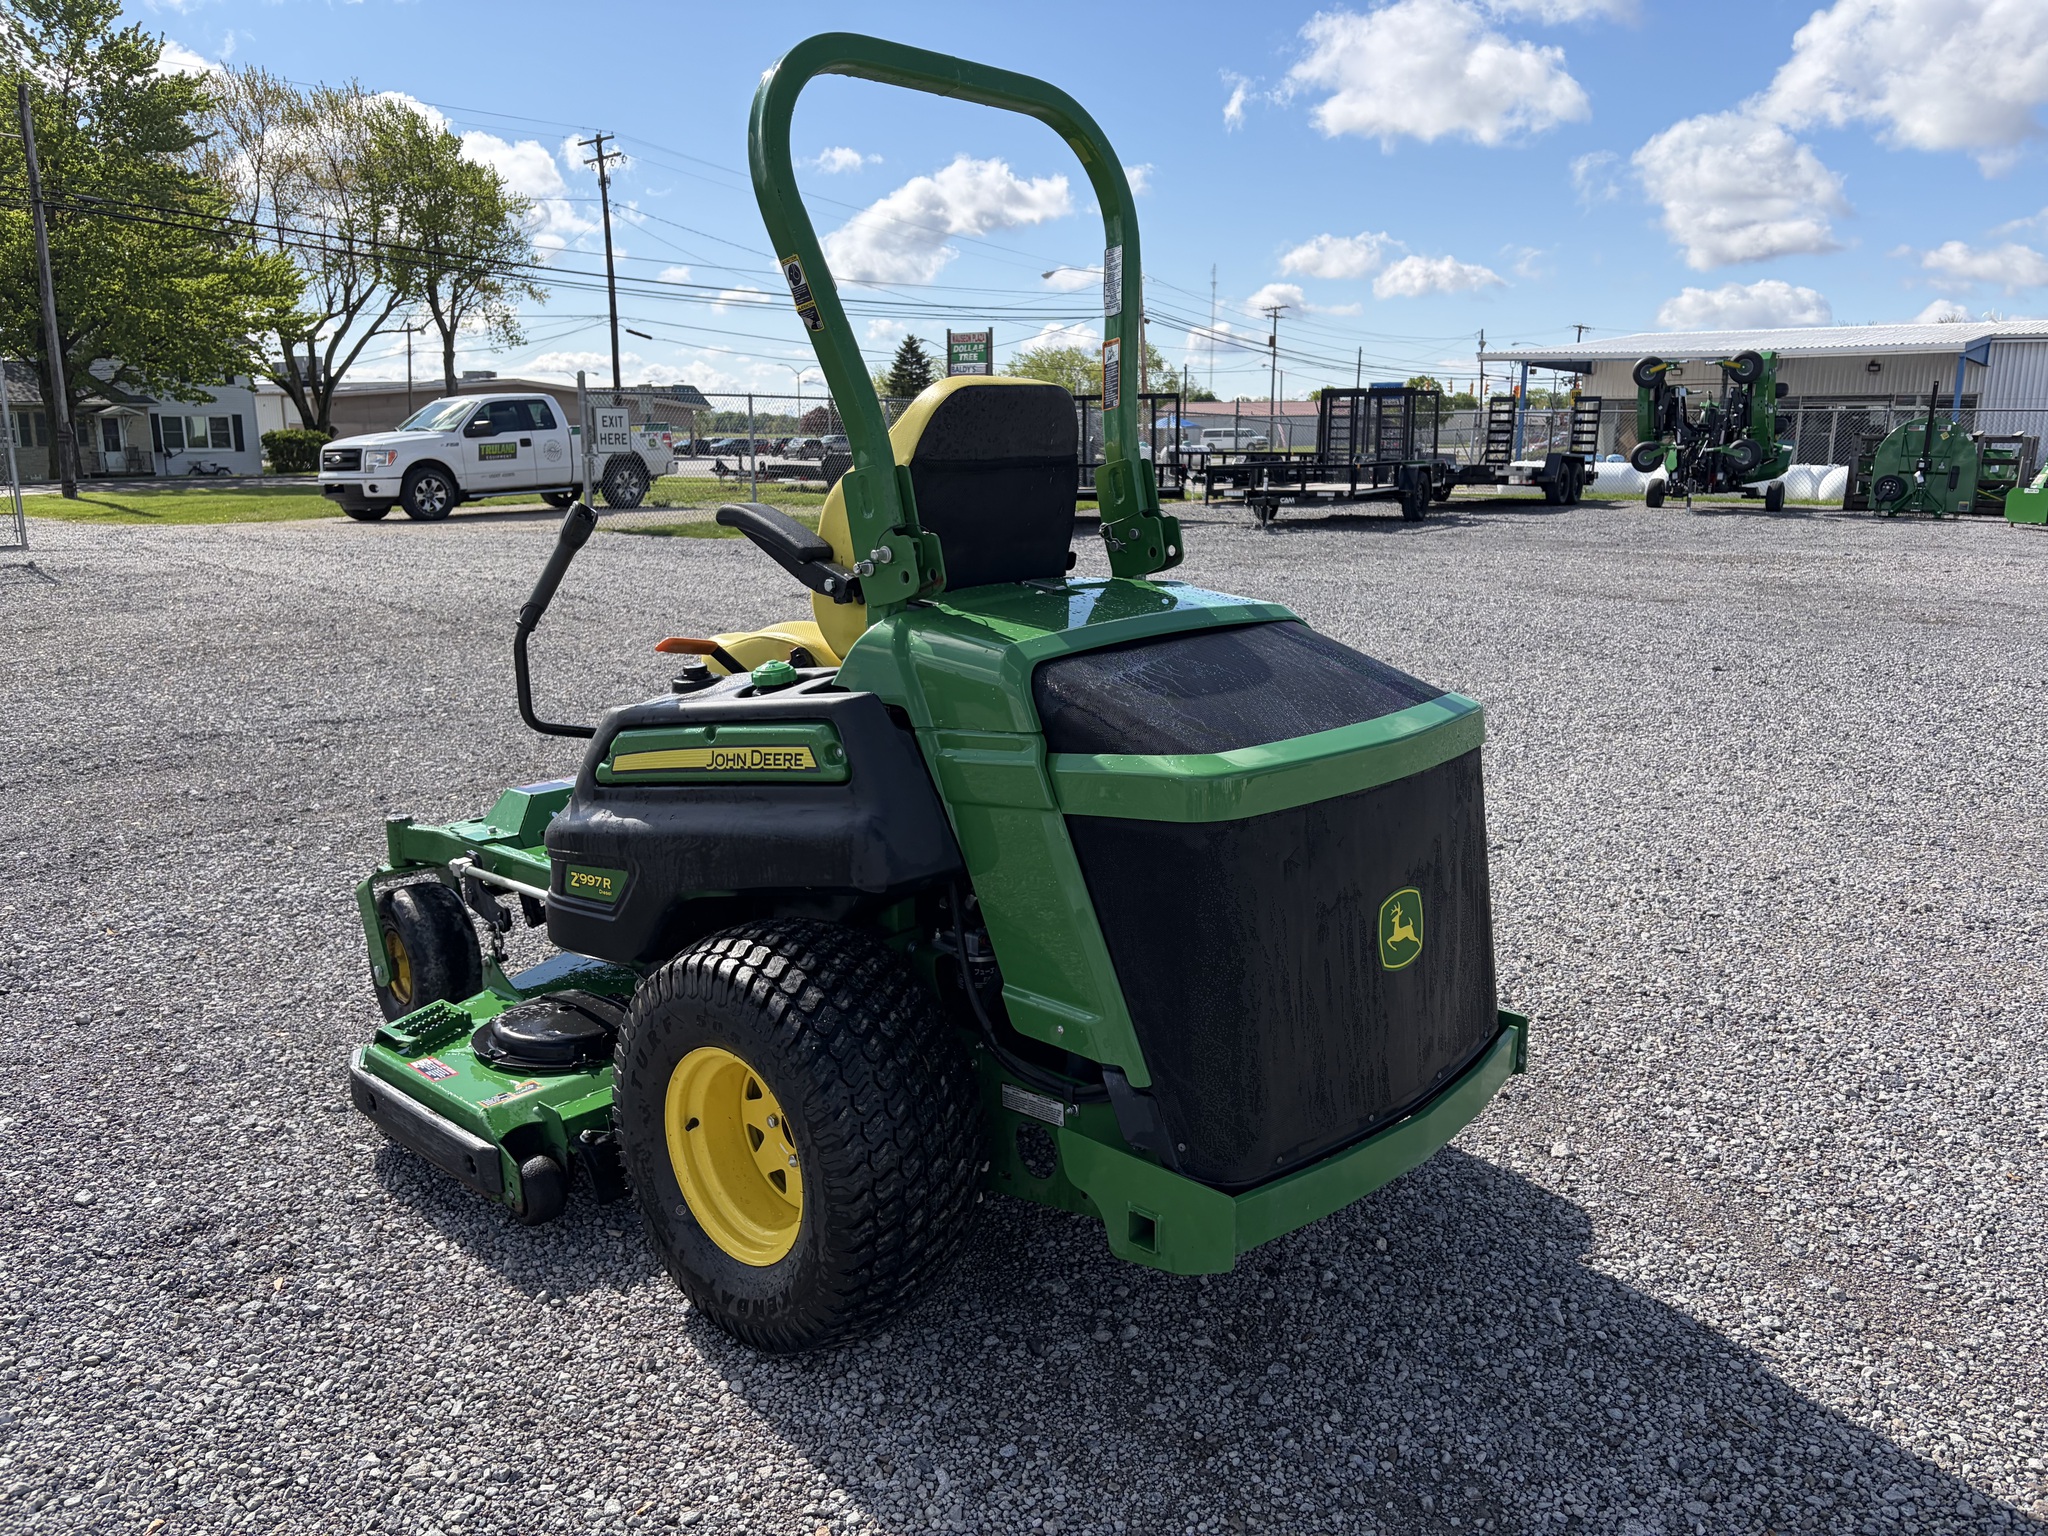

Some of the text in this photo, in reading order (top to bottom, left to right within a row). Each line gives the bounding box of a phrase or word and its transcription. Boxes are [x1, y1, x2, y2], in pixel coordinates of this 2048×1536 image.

[953, 345, 985, 353] DOLLAR
[959, 353, 978, 361] TREE
[602, 415, 623, 428] EXIT
[600, 433, 628, 445] HERE
[480, 443, 515, 455] TRULAND
[706, 750, 804, 767] JOHN DEERE
[630, 1015, 673, 1091] TURF
[721, 1285, 792, 1315] KENDA
